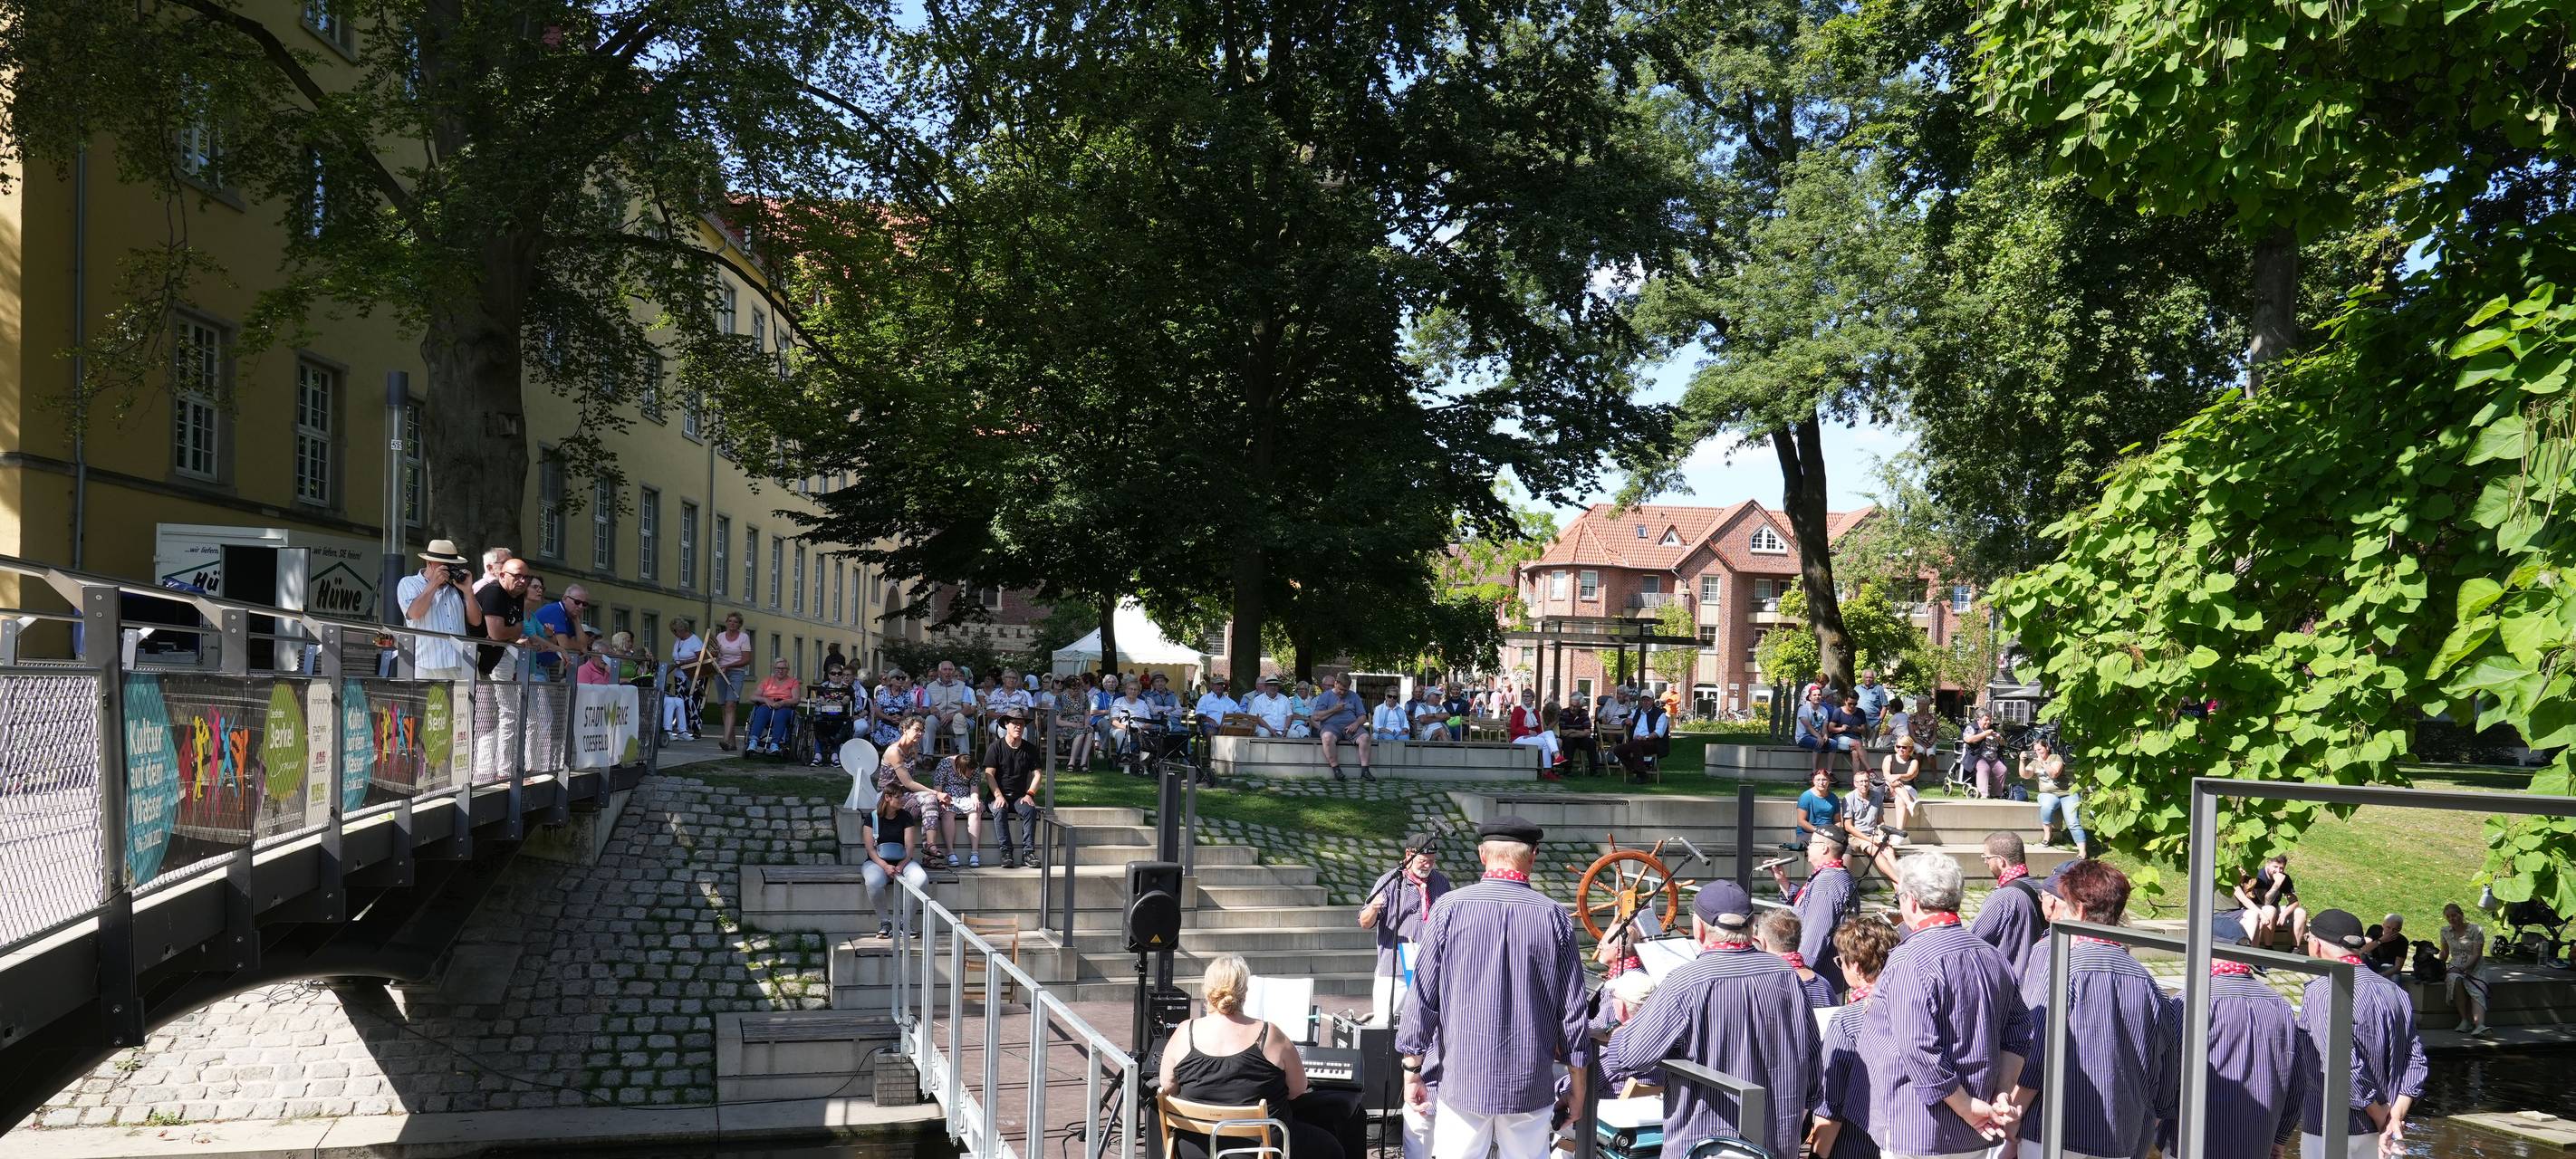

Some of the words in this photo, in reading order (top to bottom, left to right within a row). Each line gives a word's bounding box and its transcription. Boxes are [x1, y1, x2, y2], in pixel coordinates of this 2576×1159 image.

[339, 549, 348, 559] SIE
[316, 577, 362, 611] Hüwe
[130, 717, 164, 756] Kultur
[269, 722, 295, 749] Berkel
[582, 733, 609, 752] COESFELD
[130, 760, 145, 790] auf
[145, 759, 164, 787] dem
[131, 794, 163, 826] Wasser
